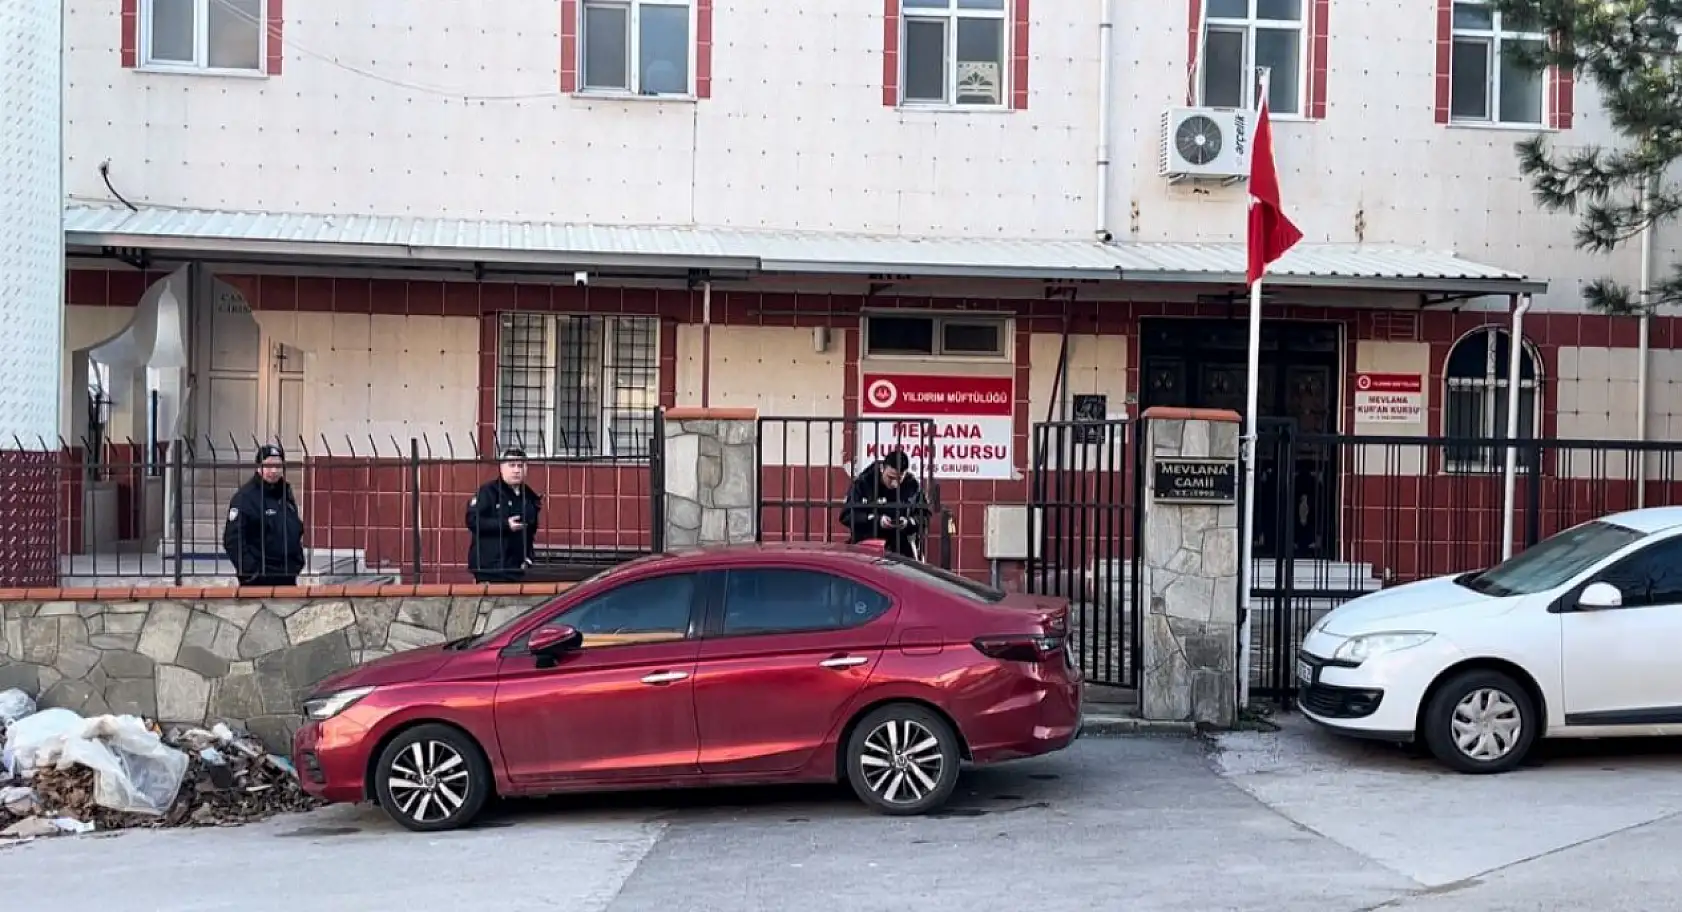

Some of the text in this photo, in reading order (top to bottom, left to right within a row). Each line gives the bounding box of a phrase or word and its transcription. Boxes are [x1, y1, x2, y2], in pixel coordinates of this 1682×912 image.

[1234, 113, 1246, 155] arçelik
[902, 391, 1008, 404] YILDIRIM MÜFTÜLÜĞÜ
[943, 444, 1007, 460] KURSU
[1161, 463, 1228, 476] MEVLANA
